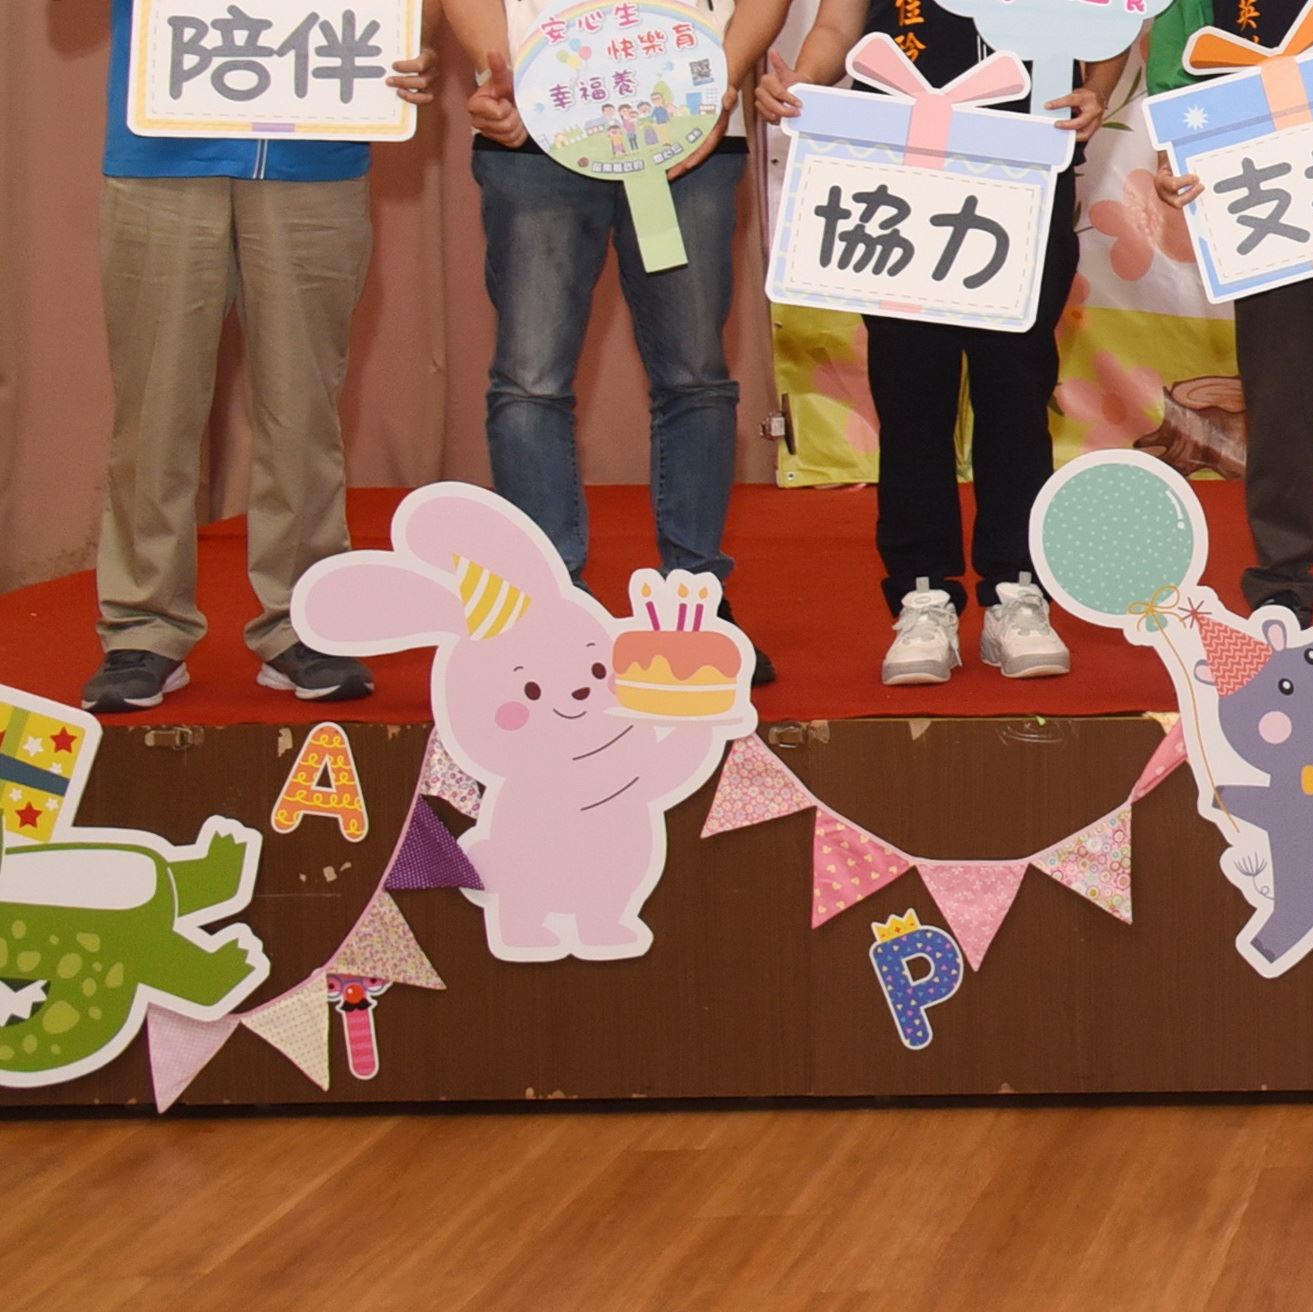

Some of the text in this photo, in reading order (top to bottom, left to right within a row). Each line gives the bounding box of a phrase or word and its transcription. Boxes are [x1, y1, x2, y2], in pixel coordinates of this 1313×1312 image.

[167, 5, 387, 104] 陪伴
[540, 4, 641, 43] 安心生
[606, 23, 698, 61] 快樂育
[550, 70, 636, 110] 幸福養
[814, 184, 1010, 291] 協力
[271, 722, 369, 842] A
[869, 918, 964, 1049] P
